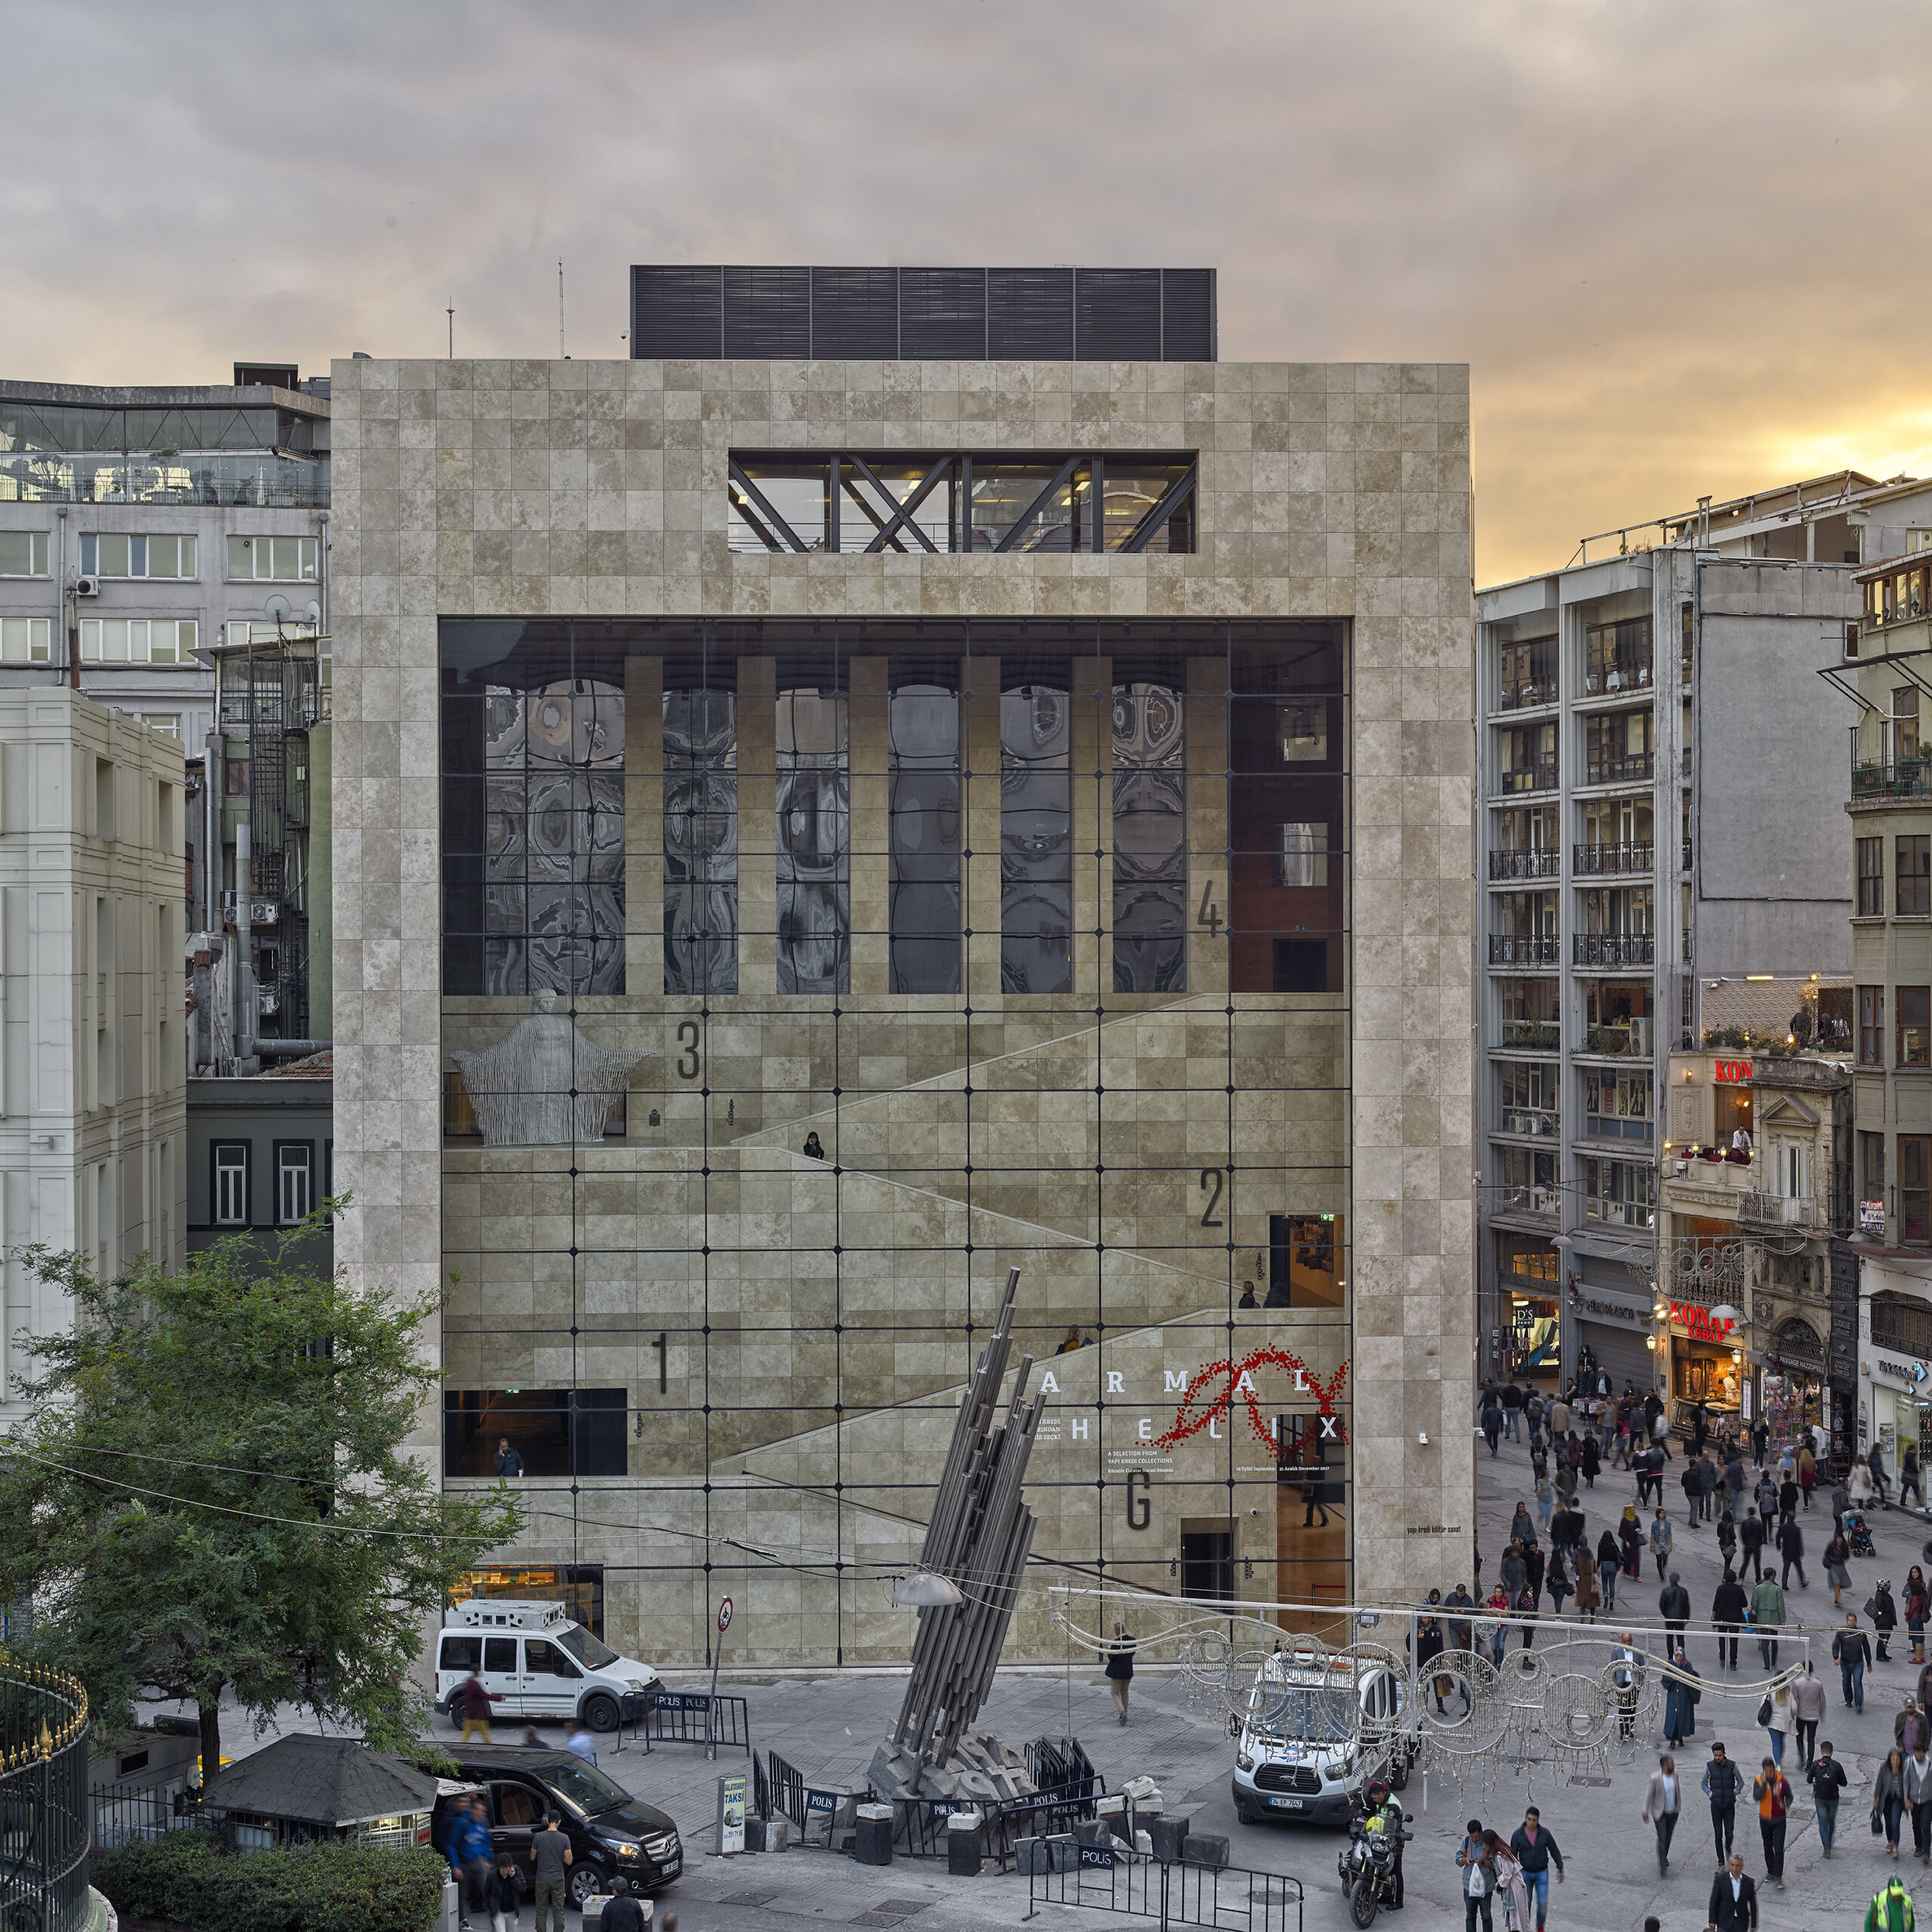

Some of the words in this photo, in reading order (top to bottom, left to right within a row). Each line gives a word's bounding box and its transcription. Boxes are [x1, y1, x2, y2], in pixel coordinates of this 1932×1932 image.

[1198, 880, 1223, 937] 4
[678, 1021, 699, 1079] 3
[1715, 1060, 1752, 1081] KON
[1201, 1168, 1223, 1226] 2
[1687, 1326, 1724, 1343] KEBAP
[651, 1333, 666, 1393] 1
[1780, 1356, 1799, 1367] PASSAGE
[1128, 1468, 1150, 1530] G
[724, 1790, 744, 1804] TAKSİ
[811, 1795, 832, 1808] POLİS
[1082, 1850, 1112, 1866] POLİS
